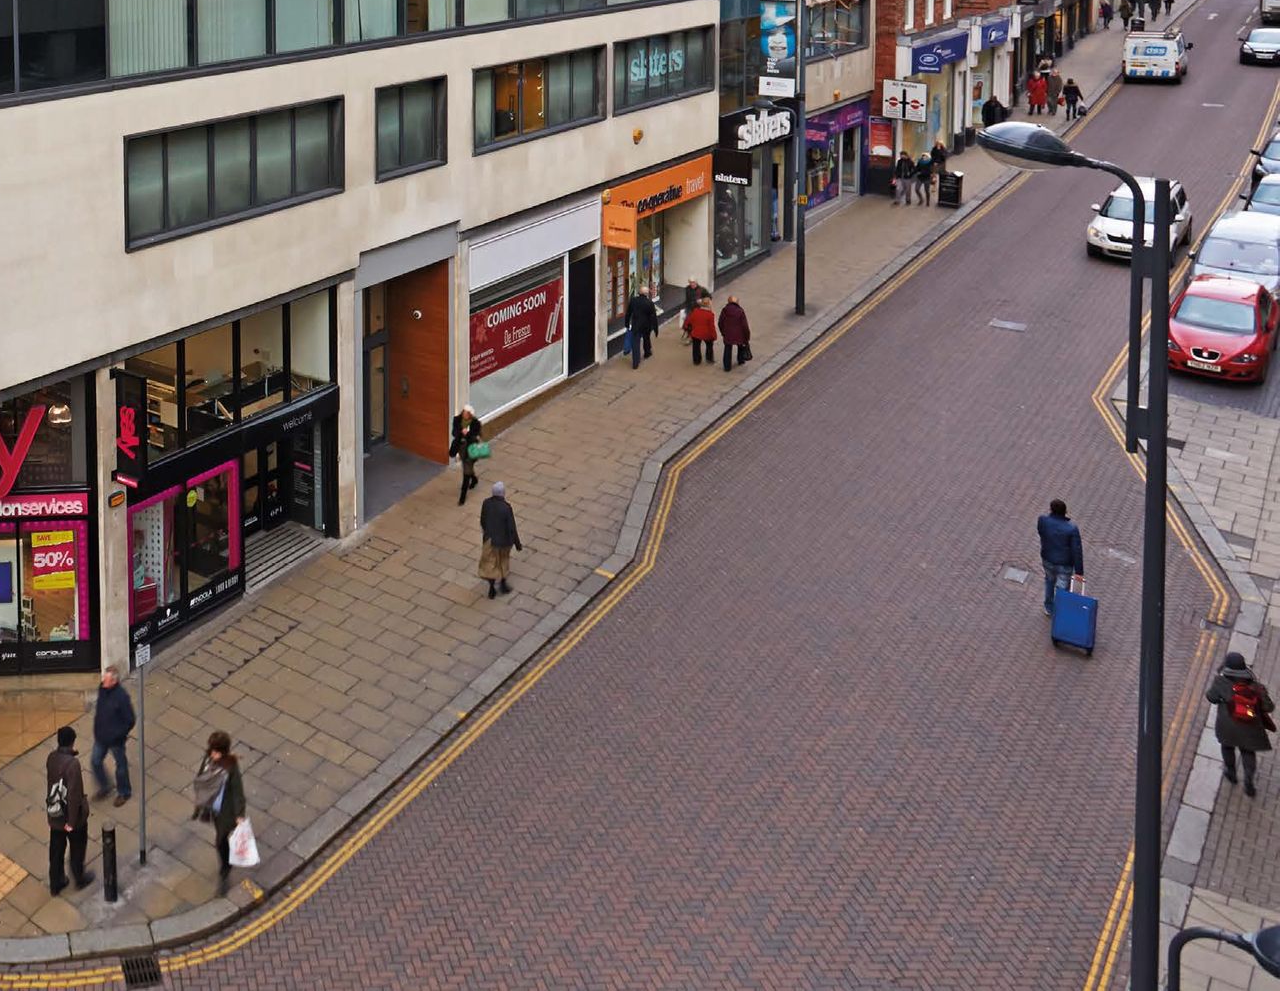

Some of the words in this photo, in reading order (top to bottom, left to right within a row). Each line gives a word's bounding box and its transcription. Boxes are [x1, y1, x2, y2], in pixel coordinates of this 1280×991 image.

[738, 109, 791, 150] slaters
[686, 172, 705, 195] travel
[715, 173, 748, 185] slaters
[487, 302, 522, 328] COMING
[523, 291, 547, 313] SOON
[504, 330, 511, 345] De
[33, 551, 74, 568] 50%
